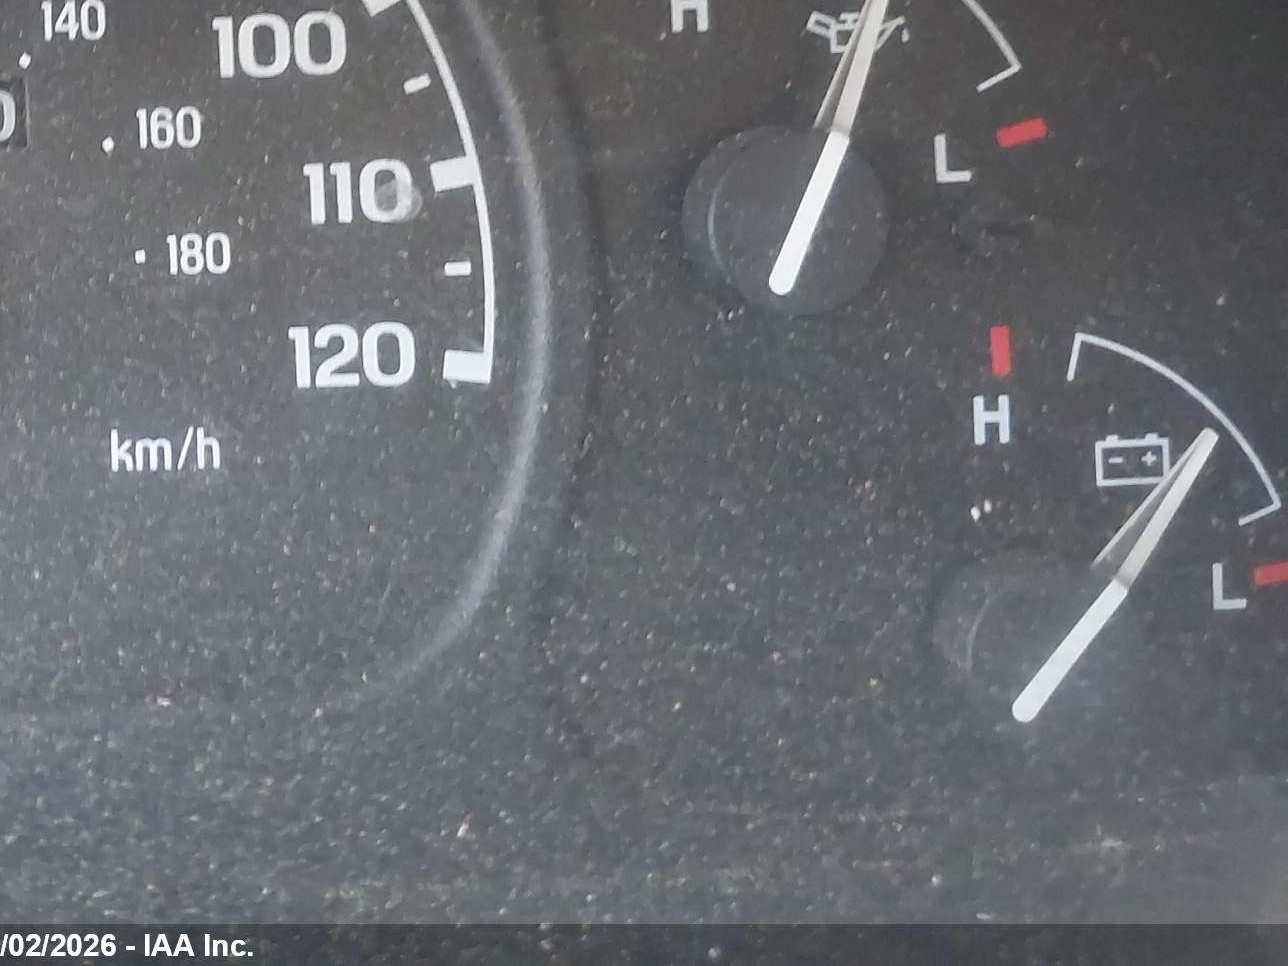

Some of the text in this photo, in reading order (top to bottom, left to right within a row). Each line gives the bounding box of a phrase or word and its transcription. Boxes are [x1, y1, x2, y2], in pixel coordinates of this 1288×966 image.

[212, 11, 348, 79] 100
[136, 106, 202, 150] 160
[934, 133, 972, 183] L
[303, 158, 415, 225] 110
[167, 232, 231, 275] 180
[288, 321, 416, 389] 120
[973, 396, 1011, 444] H
[109, 426, 222, 473] km/h
[1213, 562, 1247, 611] L
